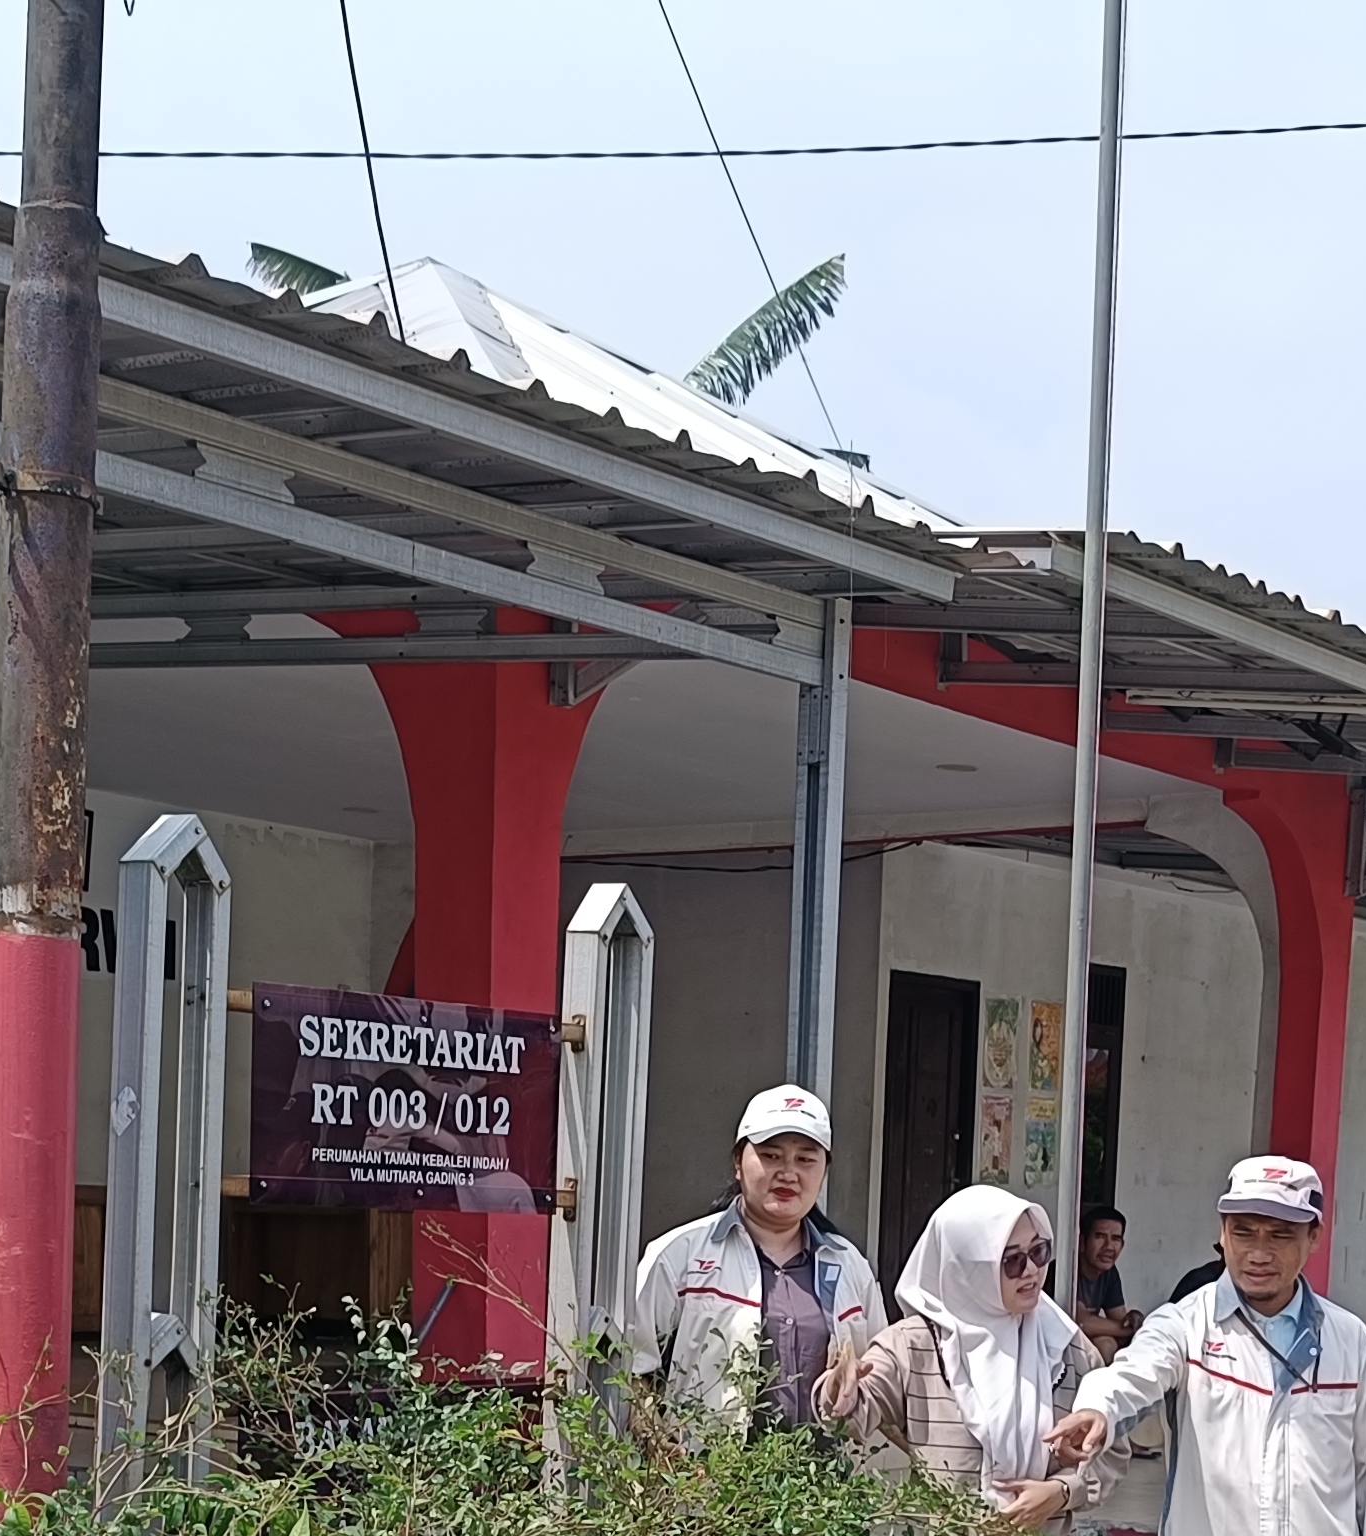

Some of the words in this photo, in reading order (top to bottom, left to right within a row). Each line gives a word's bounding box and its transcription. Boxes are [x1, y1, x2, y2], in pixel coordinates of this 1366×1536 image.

[299, 1014, 526, 1074] SEKRETARIAT
[311, 1083, 359, 1126] RT
[368, 1087, 427, 1130] 003
[455, 1093, 510, 1135] 012
[312, 1147, 382, 1165] PERUMAHAN
[384, 1151, 420, 1167] TAMAN
[422, 1153, 471, 1169] KEBALEN
[472, 1156, 504, 1171] INDAH
[350, 1168, 375, 1182] VILA
[376, 1169, 424, 1184] MUTIARA
[425, 1171, 466, 1186] GADING
[467, 1173, 475, 1186] 3
